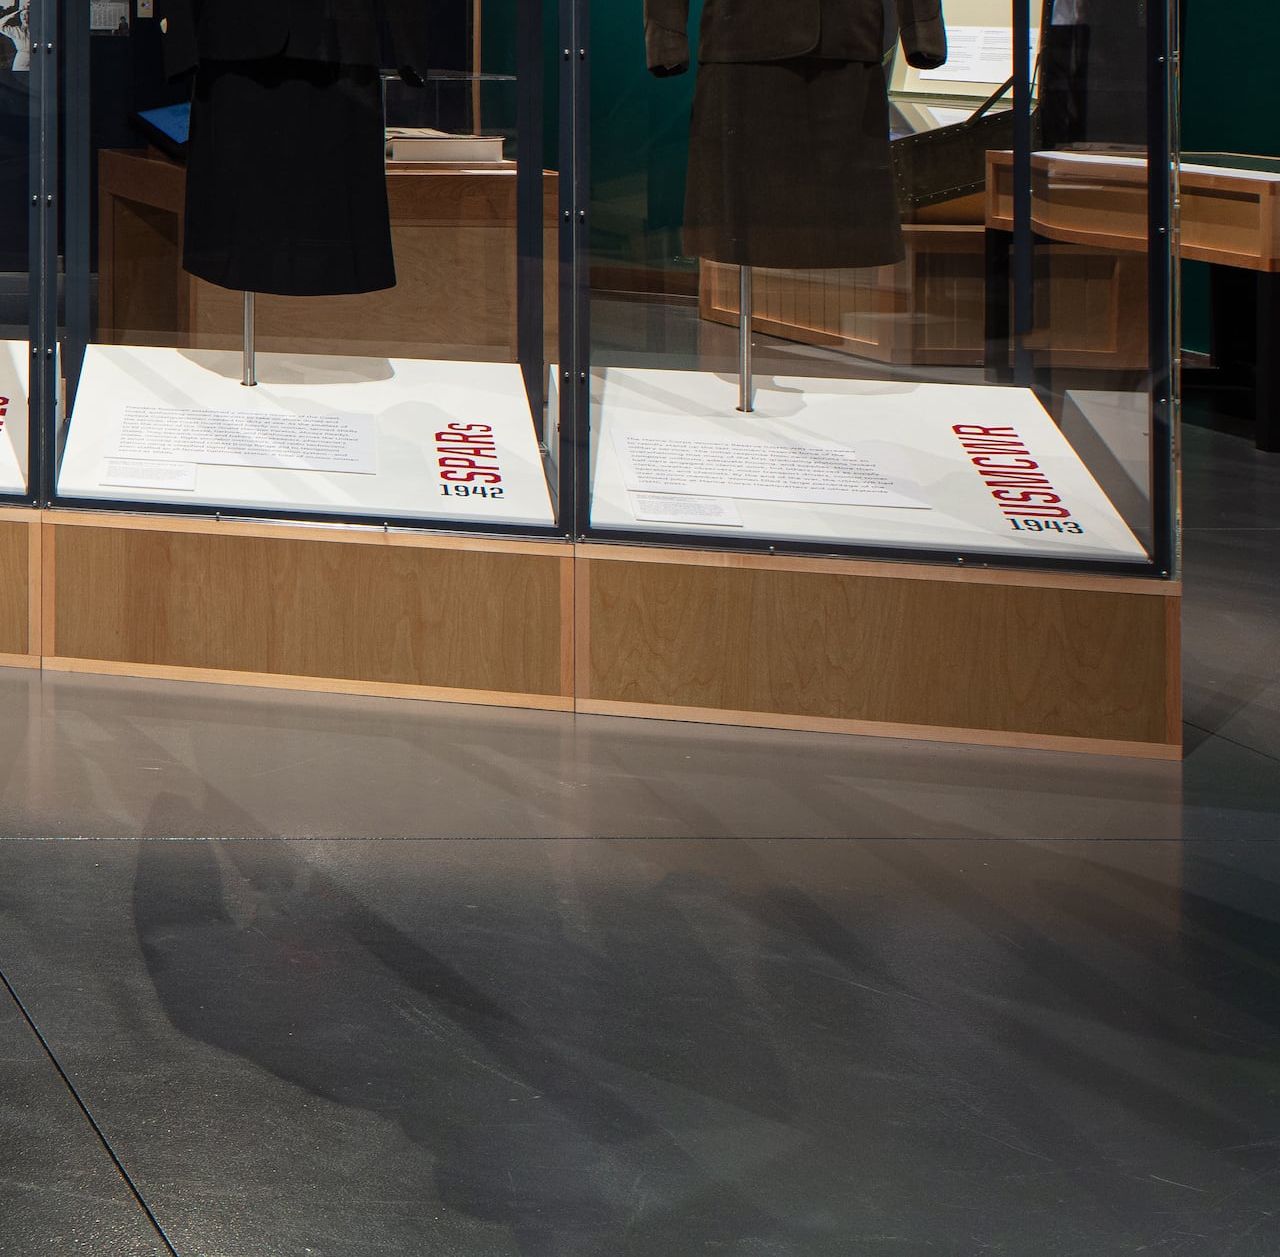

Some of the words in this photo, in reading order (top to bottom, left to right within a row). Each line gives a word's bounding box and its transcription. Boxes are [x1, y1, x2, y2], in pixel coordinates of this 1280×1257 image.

[952, 424, 1071, 518] USMCWR
[439, 483, 504, 499] 1942
[1006, 518, 1084, 534] 1943
